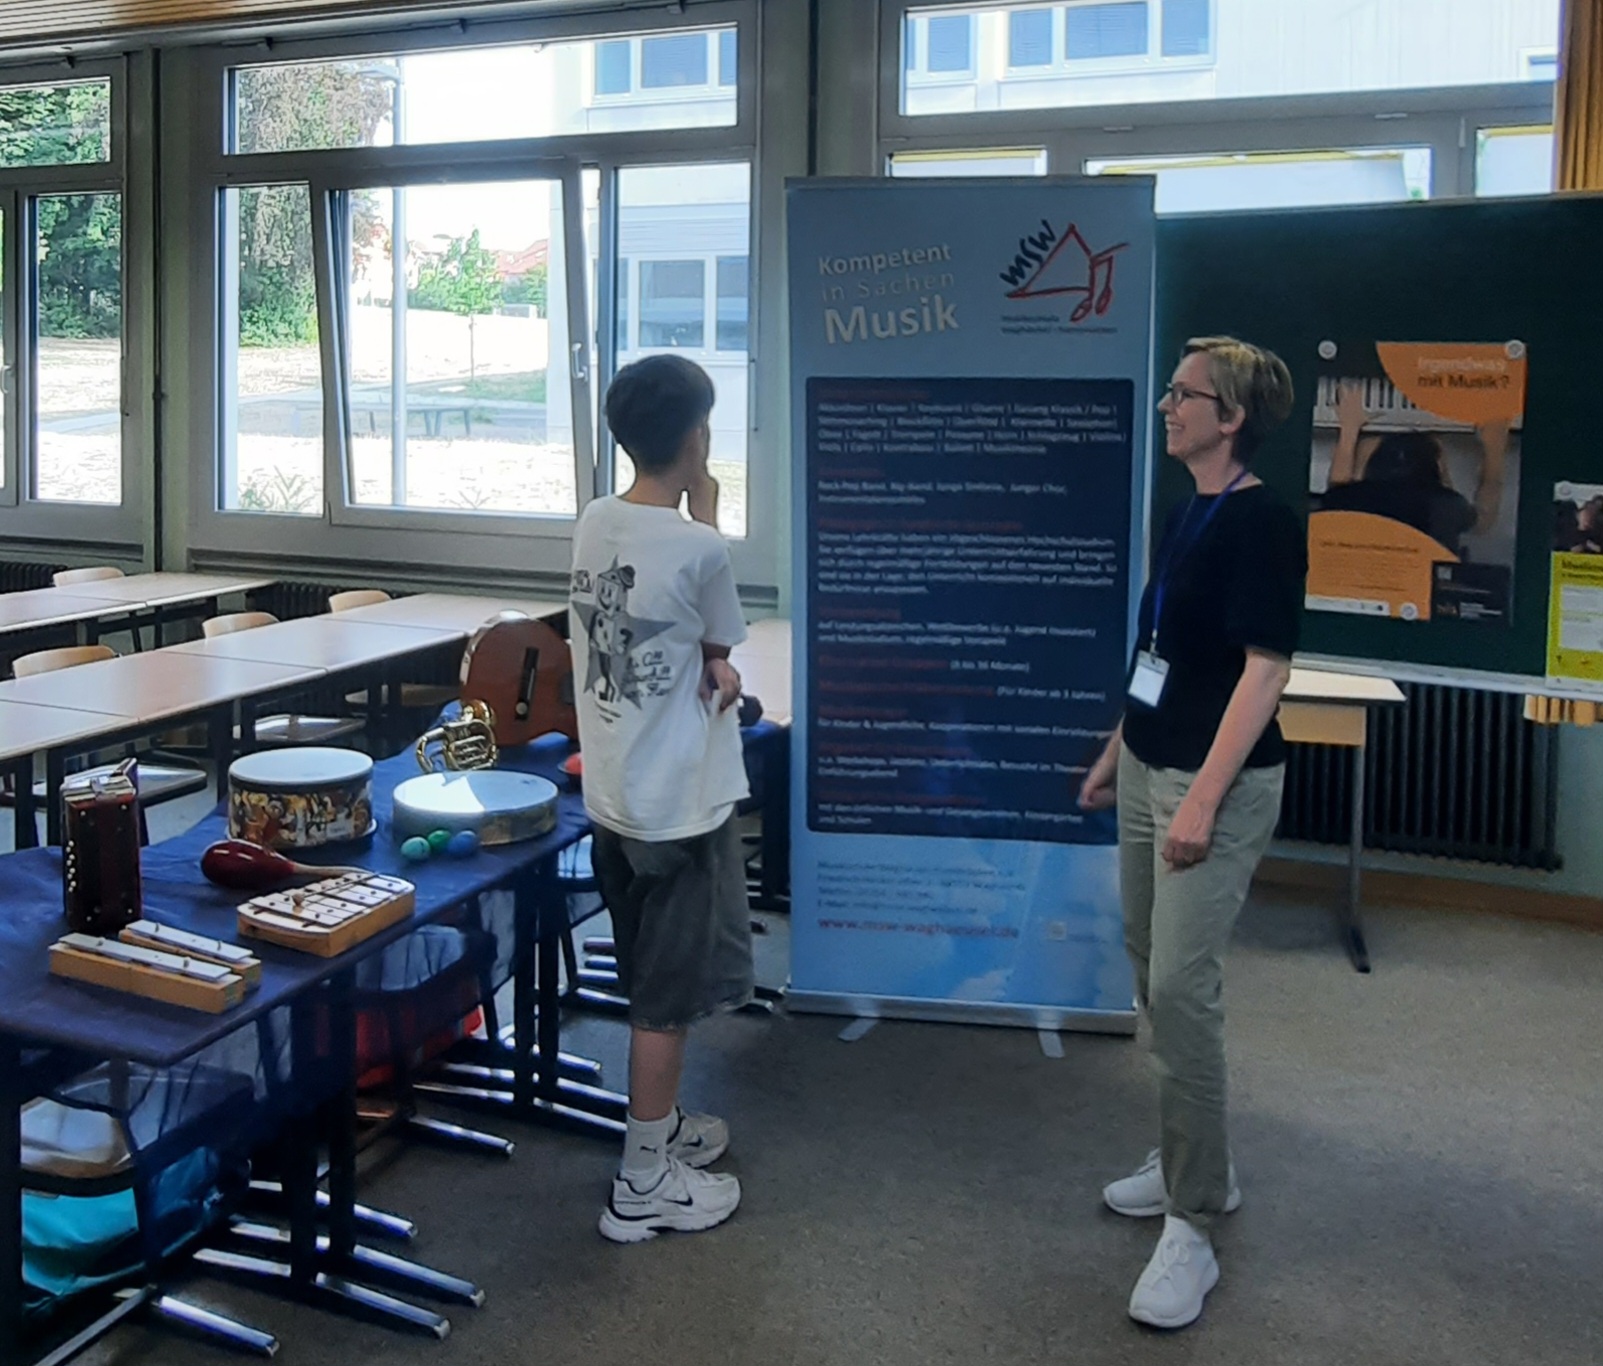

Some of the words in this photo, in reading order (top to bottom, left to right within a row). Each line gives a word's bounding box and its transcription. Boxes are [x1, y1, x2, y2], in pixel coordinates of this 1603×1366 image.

[818, 241, 953, 276] Kompetent
[822, 280, 846, 303] in
[857, 271, 956, 300] Sachen
[824, 292, 960, 345] Musik
